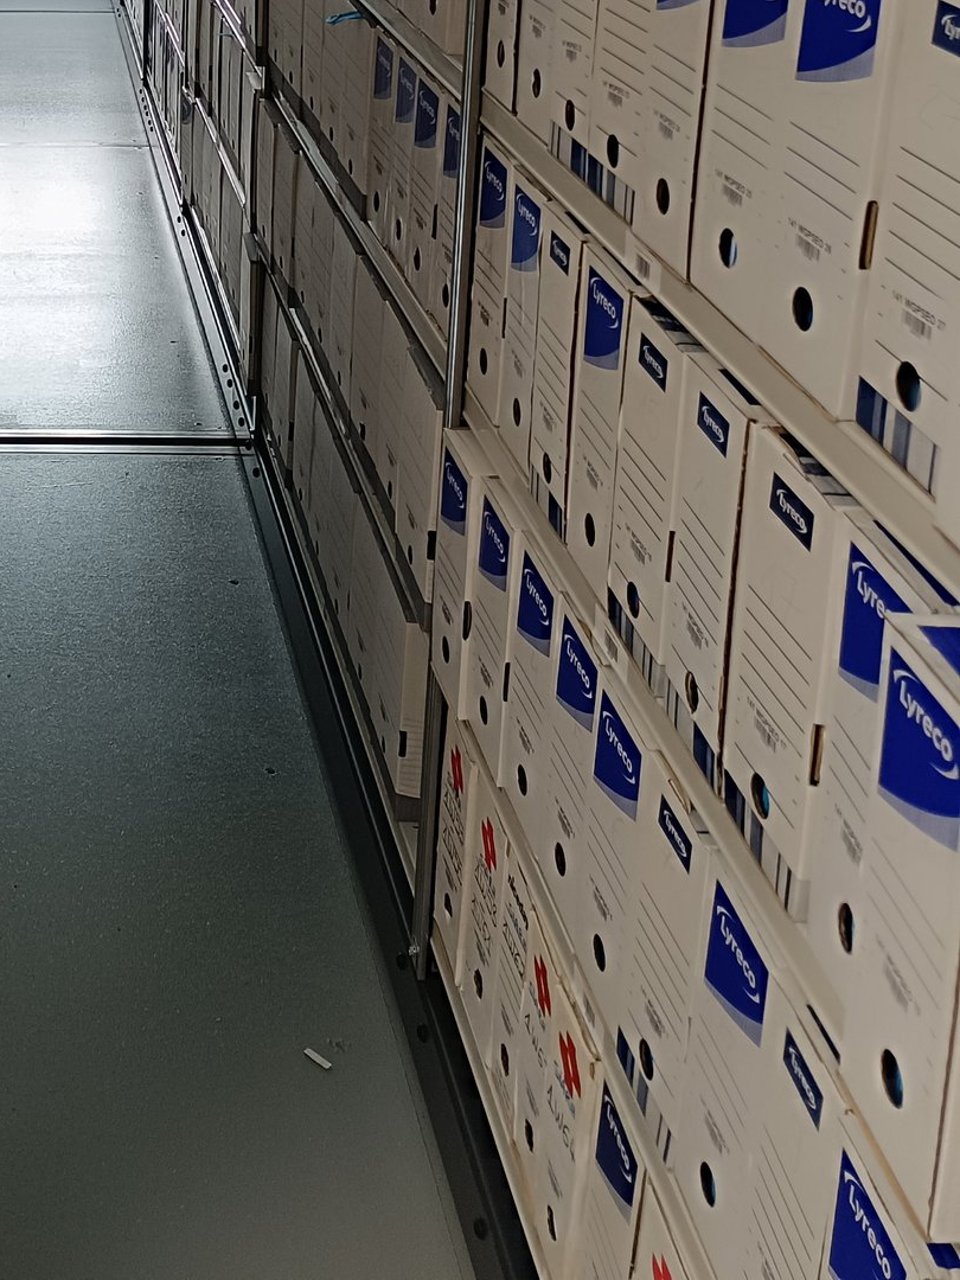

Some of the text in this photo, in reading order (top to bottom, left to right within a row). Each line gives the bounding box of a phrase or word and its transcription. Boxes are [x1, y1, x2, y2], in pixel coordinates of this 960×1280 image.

[486, 170, 503, 194] Lyreco
[517, 203, 537, 228] Lyreco
[592, 283, 617, 319] Lyreco
[643, 349, 663, 375] Lyreco
[703, 411, 724, 442] Lyreco
[445, 472, 464, 503] Lyreco
[777, 494, 807, 531] Lyreco
[483, 520, 505, 555] Lyreco
[525, 574, 548, 618] Lyreco
[856, 570, 886, 620] Lyre
[566, 643, 591, 690] Lyreco
[899, 680, 954, 762] Lyreco
[605, 719, 633, 774] Lyreco
[663, 813, 686, 855] Lyreco
[720, 915, 755, 990] Lyreco
[789, 1053, 816, 1108] Lyreco
[605, 1103, 629, 1173] Lyreco
[848, 1183, 892, 1280] Lyreco
